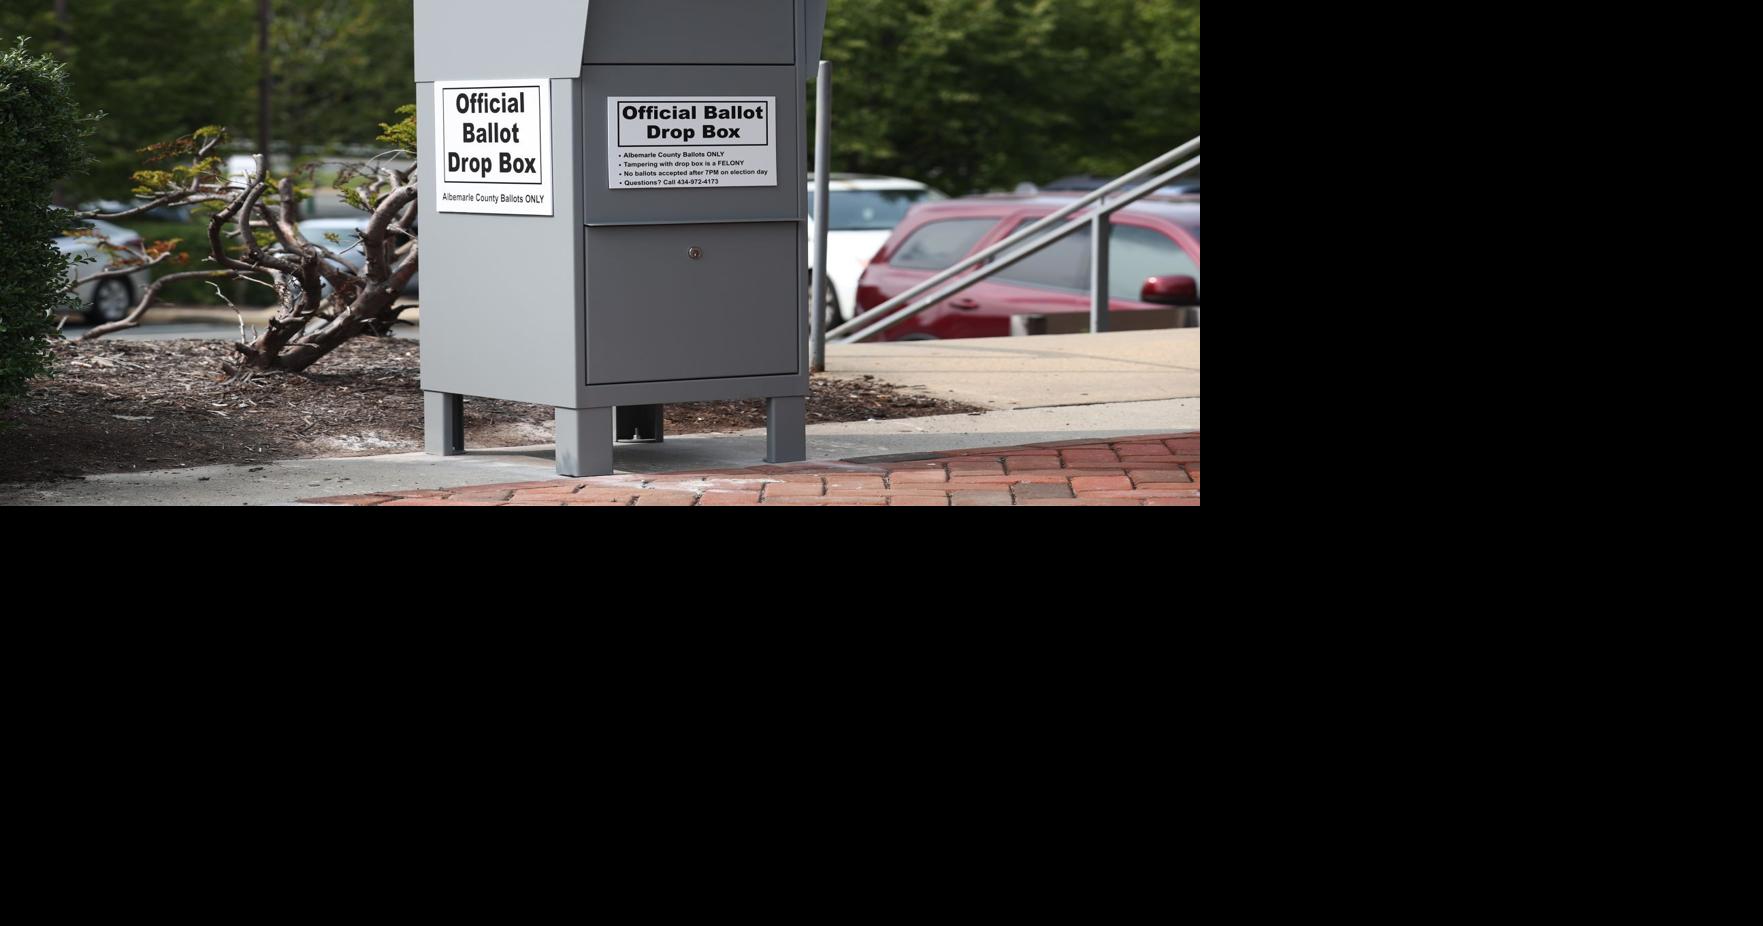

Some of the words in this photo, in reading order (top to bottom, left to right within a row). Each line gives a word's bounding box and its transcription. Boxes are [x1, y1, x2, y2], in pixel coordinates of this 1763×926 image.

[456, 92, 524, 114] Official
[622, 105, 696, 120] Official
[704, 105, 764, 120] Ballot
[463, 122, 520, 143] Ballot
[647, 125, 695, 142] Drop
[702, 124, 740, 138] Box
[448, 152, 492, 178] Drop
[499, 152, 536, 174] Box
[442, 193, 474, 202] Albemarle
[476, 193, 499, 204] County
[500, 194, 523, 203] Ballots
[525, 195, 544, 204] ONLY
